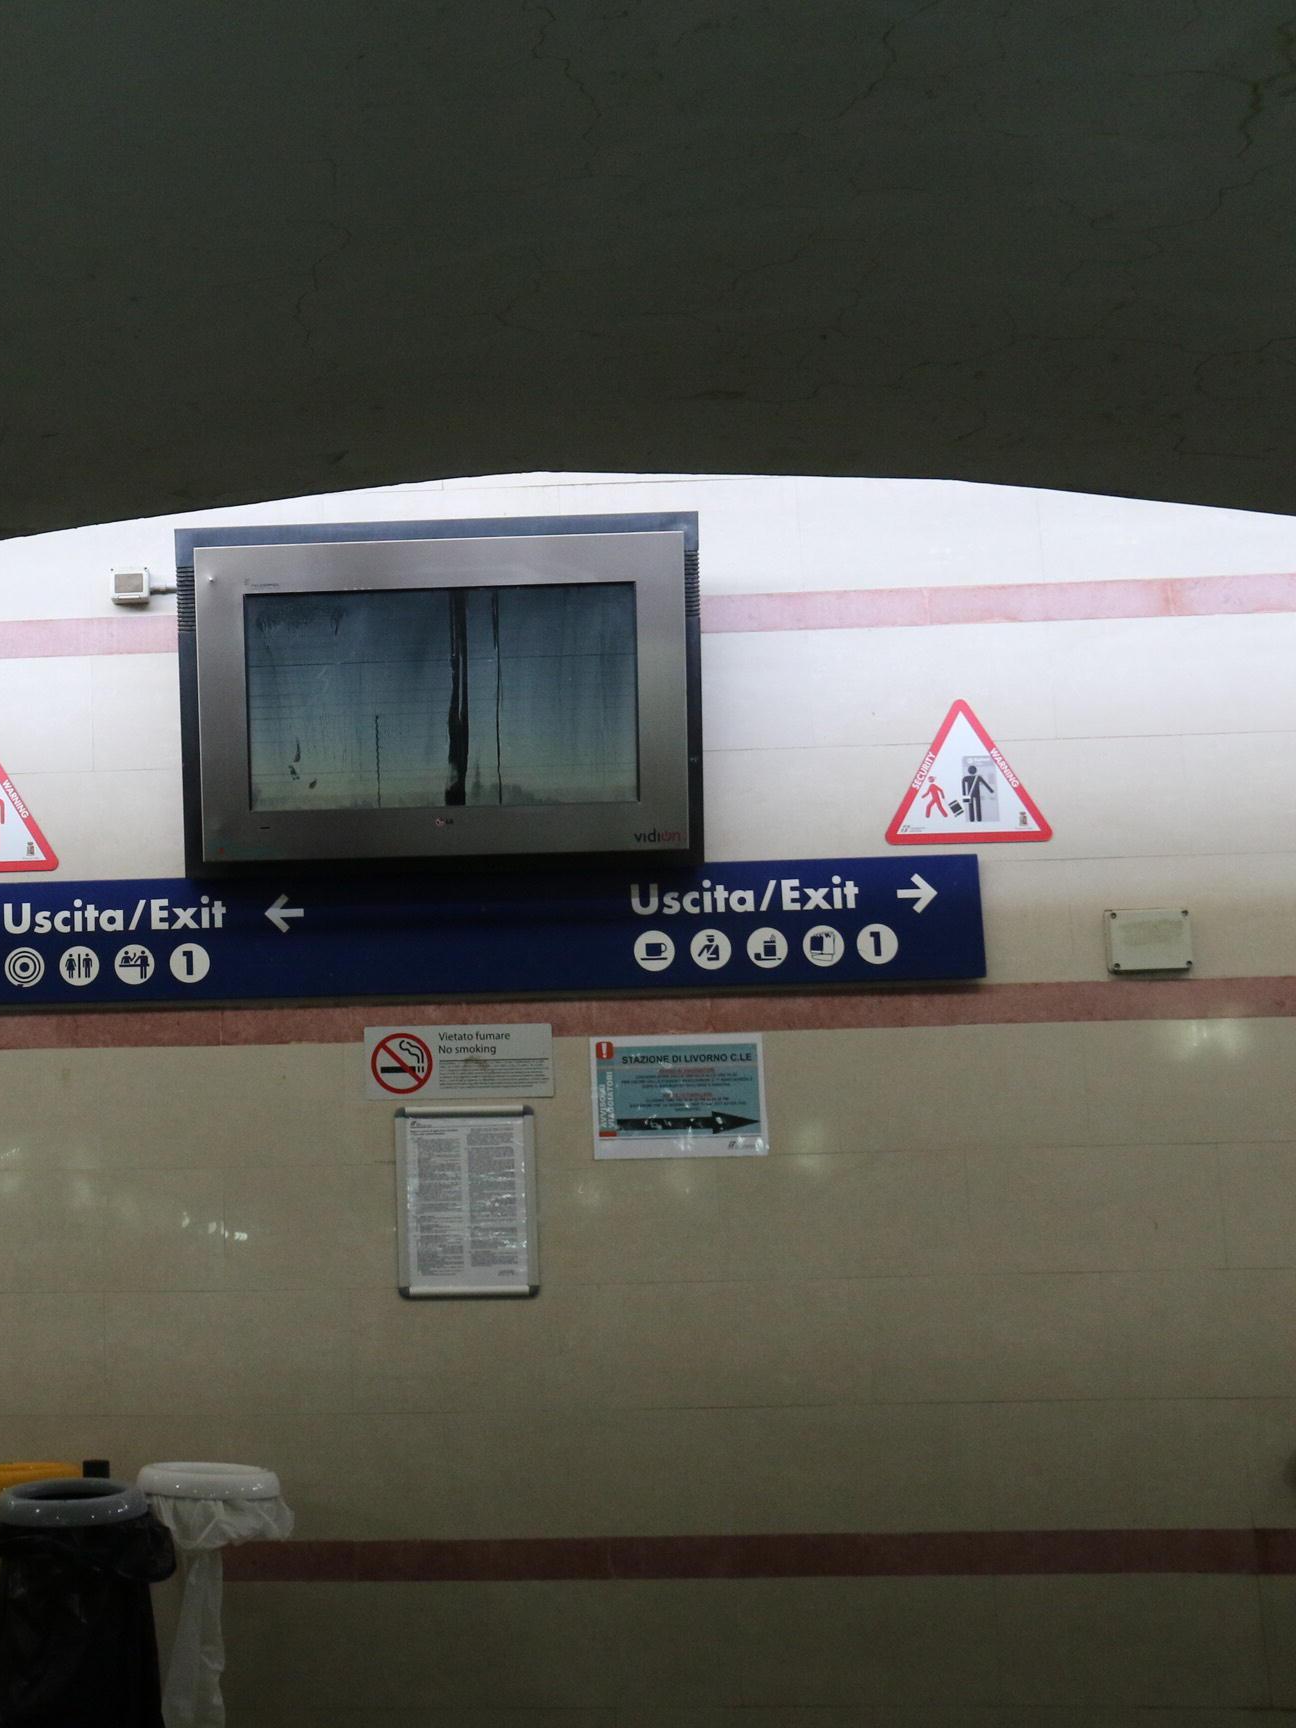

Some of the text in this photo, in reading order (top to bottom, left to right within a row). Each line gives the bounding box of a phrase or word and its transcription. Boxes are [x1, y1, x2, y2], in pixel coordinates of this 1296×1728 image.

[912, 752, 936, 789] SECURITY
[990, 747, 1020, 788] WARNING
[2, 779, 30, 819] WARNING
[630, 875, 859, 916] Uscita/Exit
[3, 895, 227, 934] Uscita/Exit
[869, 931, 882, 957] 1
[182, 950, 194, 976] 1
[438, 1031, 511, 1042] Vietato fumare
[438, 1044, 497, 1055] No smoking
[622, 1055, 669, 1064] STAZIONE
[672, 1055, 682, 1063] DI
[684, 1053, 728, 1063] LIVORNO
